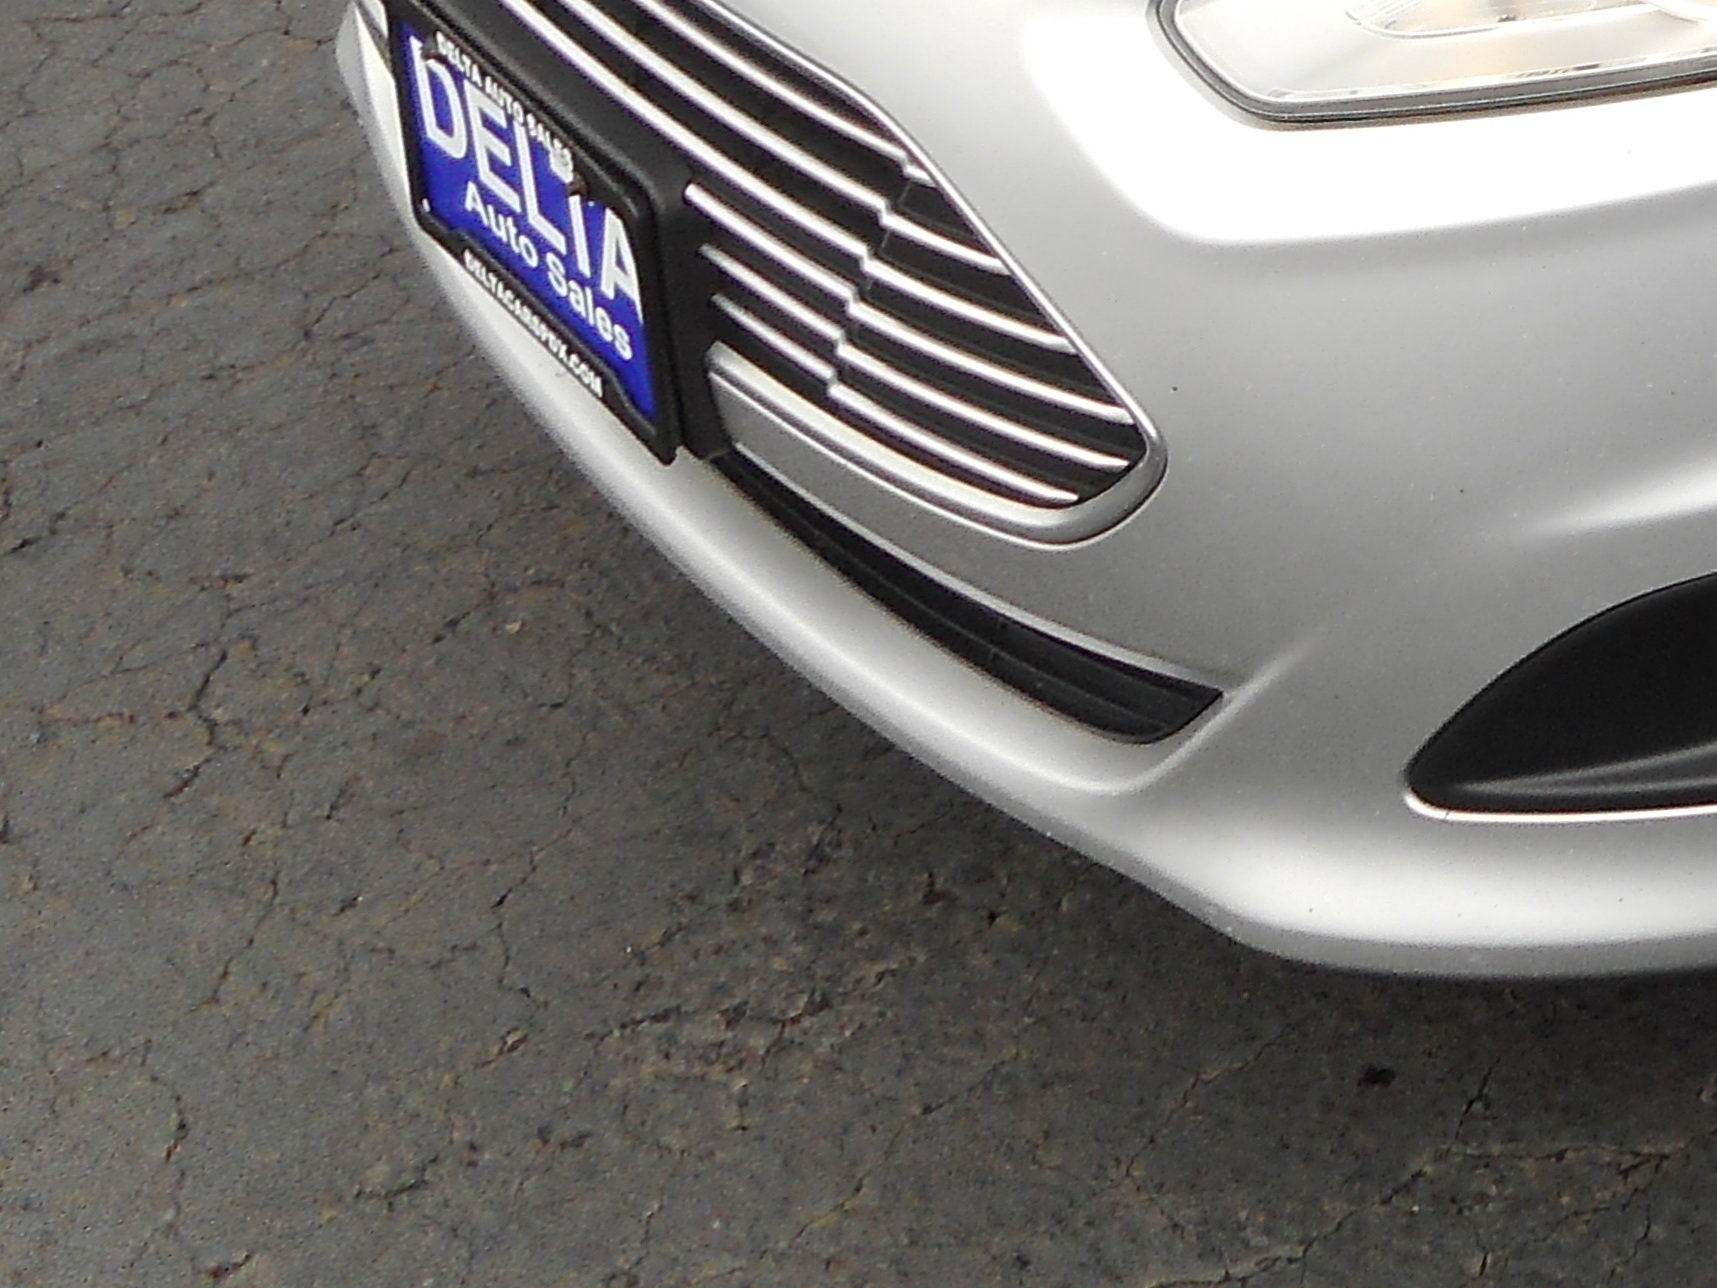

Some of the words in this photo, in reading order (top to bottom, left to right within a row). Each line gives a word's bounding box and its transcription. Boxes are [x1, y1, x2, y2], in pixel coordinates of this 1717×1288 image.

[484, 75, 525, 125] AUTO
[464, 180, 538, 270] Auto
[546, 252, 633, 361] Sales
